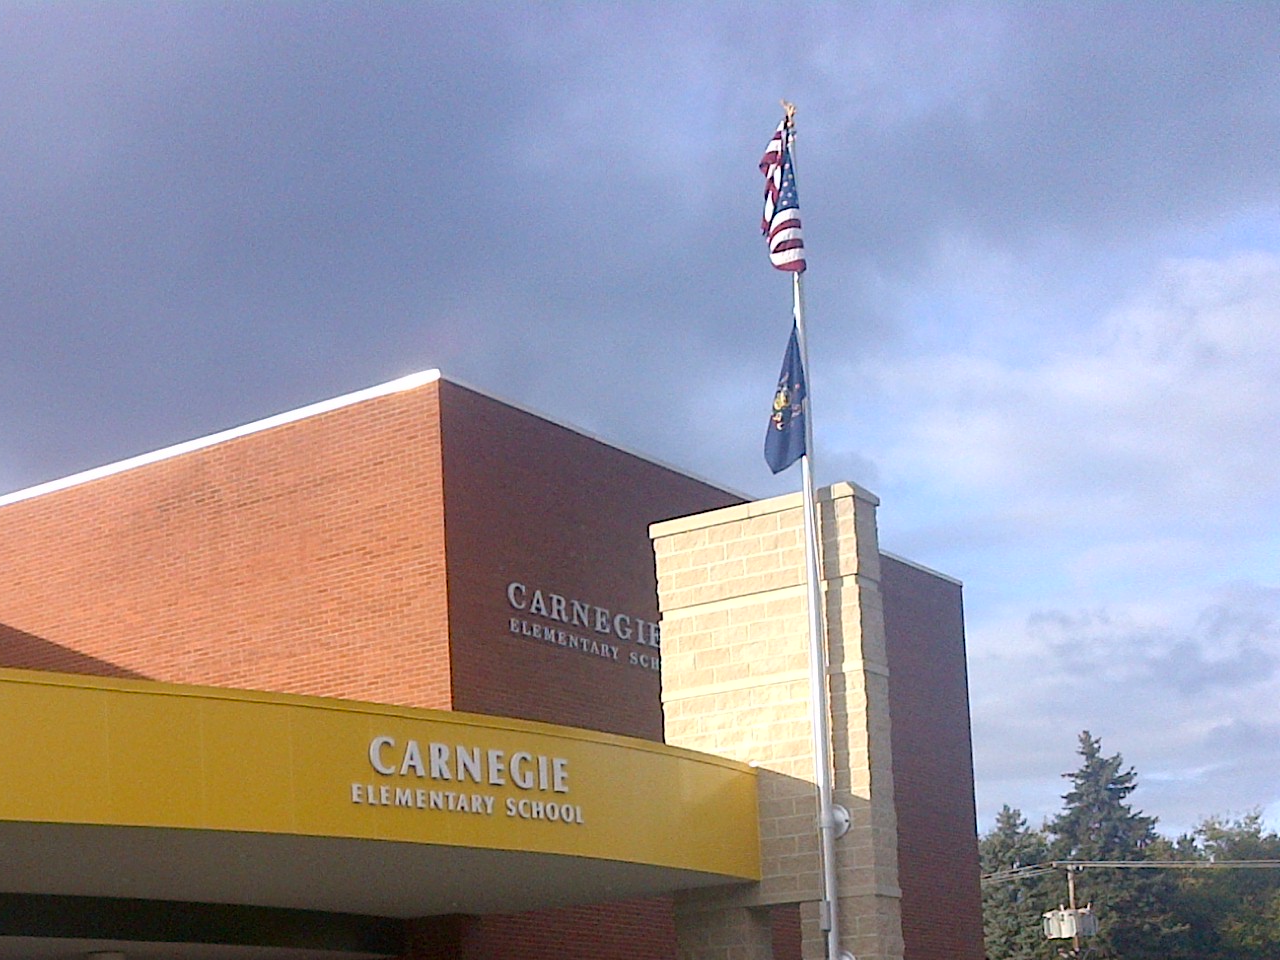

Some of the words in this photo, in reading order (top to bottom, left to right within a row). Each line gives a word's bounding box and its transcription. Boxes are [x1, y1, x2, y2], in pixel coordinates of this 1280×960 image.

[507, 582, 660, 648] CARNEGIE
[509, 618, 619, 660] ELEMENTARY
[369, 735, 569, 793] CARNEGIE
[351, 784, 495, 815] ELEMENTARY
[506, 798, 585, 824] SCHOOL
